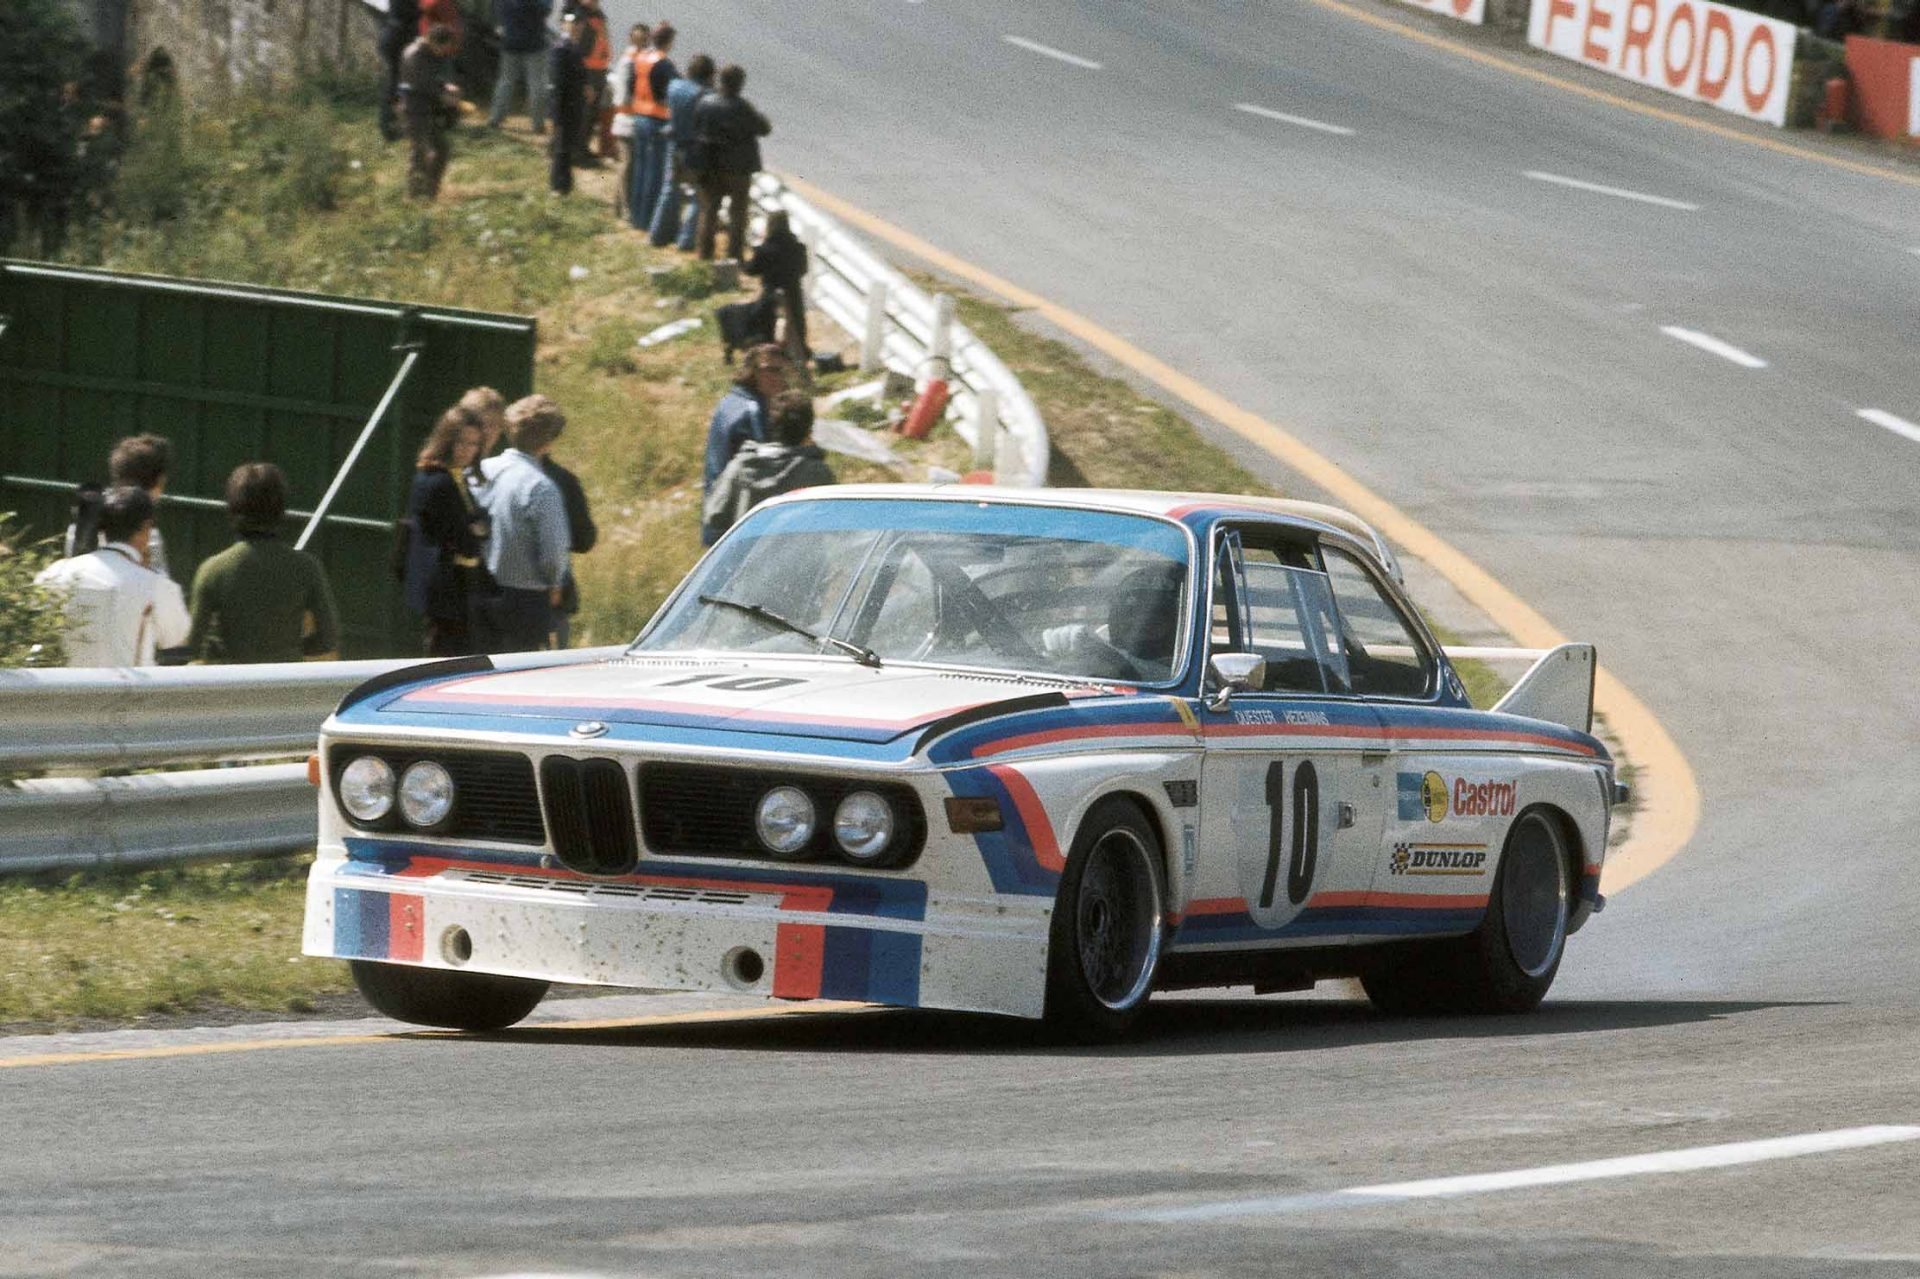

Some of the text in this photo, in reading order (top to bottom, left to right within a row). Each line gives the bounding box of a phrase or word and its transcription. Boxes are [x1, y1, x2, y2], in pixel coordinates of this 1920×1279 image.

[1543, 0, 1777, 113] FERODO
[653, 673, 811, 691] 10
[1453, 777, 1518, 816] Castrol
[1258, 760, 1319, 908] 10
[1410, 851, 1487, 868] DUNLOP
